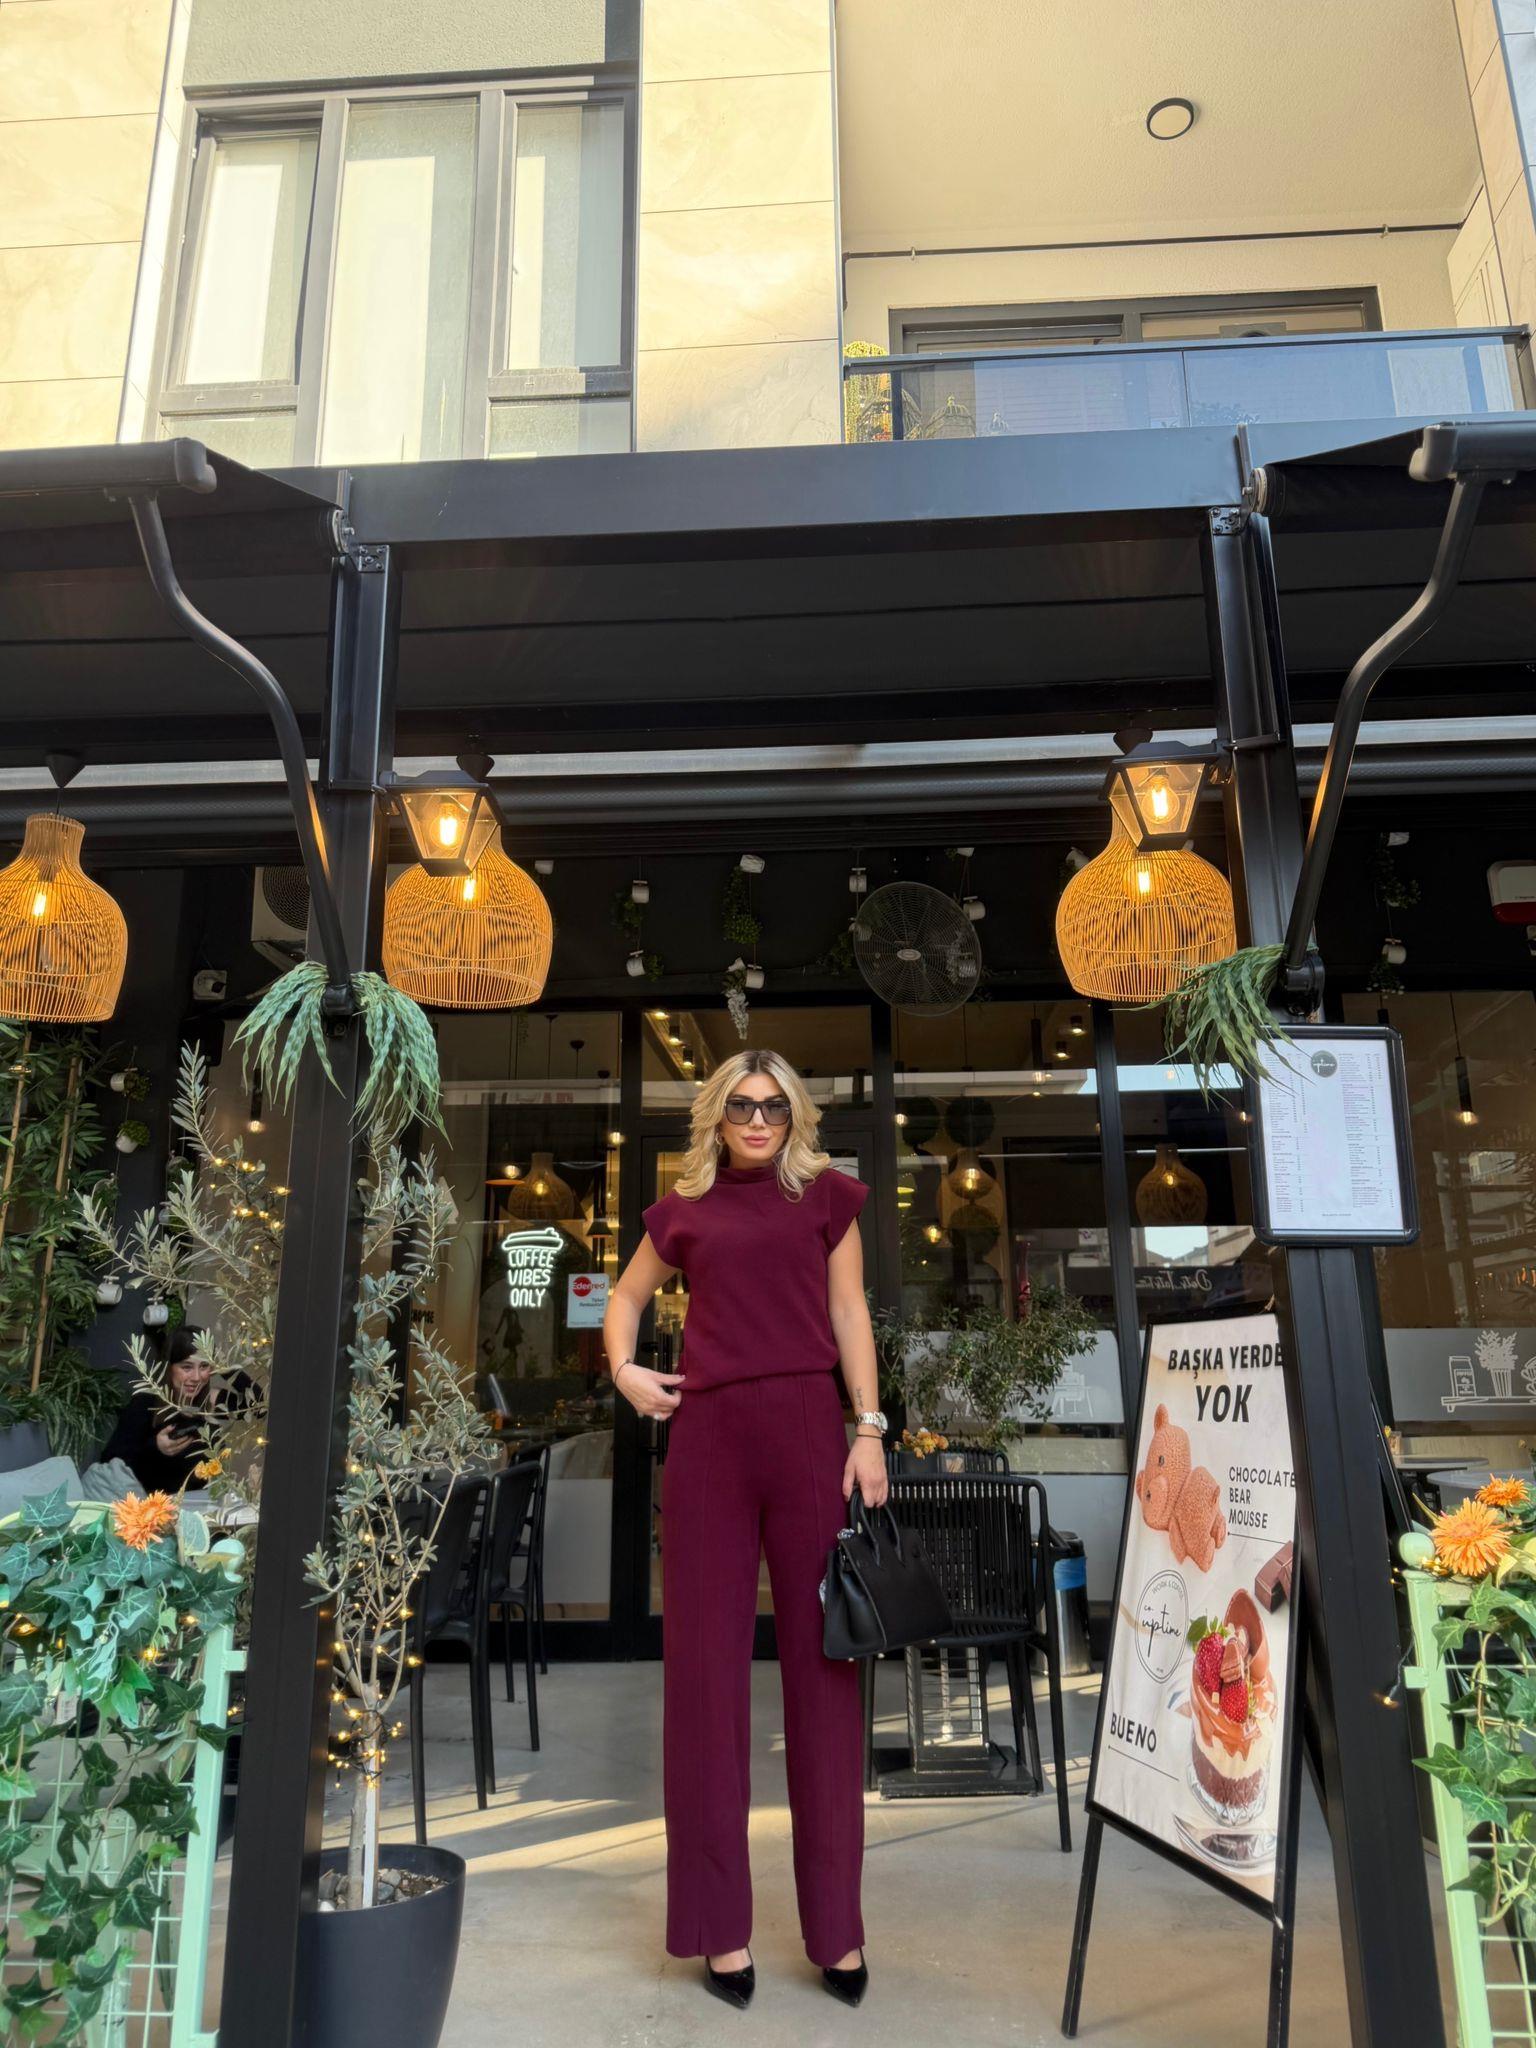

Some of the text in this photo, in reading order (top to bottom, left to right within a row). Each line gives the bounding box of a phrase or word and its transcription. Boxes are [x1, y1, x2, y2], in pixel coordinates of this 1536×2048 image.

[507, 1248, 557, 1268] COFFEE
[507, 1268, 551, 1286] VIBES
[510, 1288, 546, 1308] ONLY
[1167, 1342, 1283, 1380] BAŞKA YERDE
[1195, 1384, 1253, 1423] YOK
[1228, 1466, 1296, 1488] CHOCOLATE
[1229, 1487, 1251, 1504] BEAR
[1228, 1508, 1269, 1529] MOUSSE
[1142, 1603, 1181, 1658] uptime
[1110, 1712, 1157, 1753] BUENO
